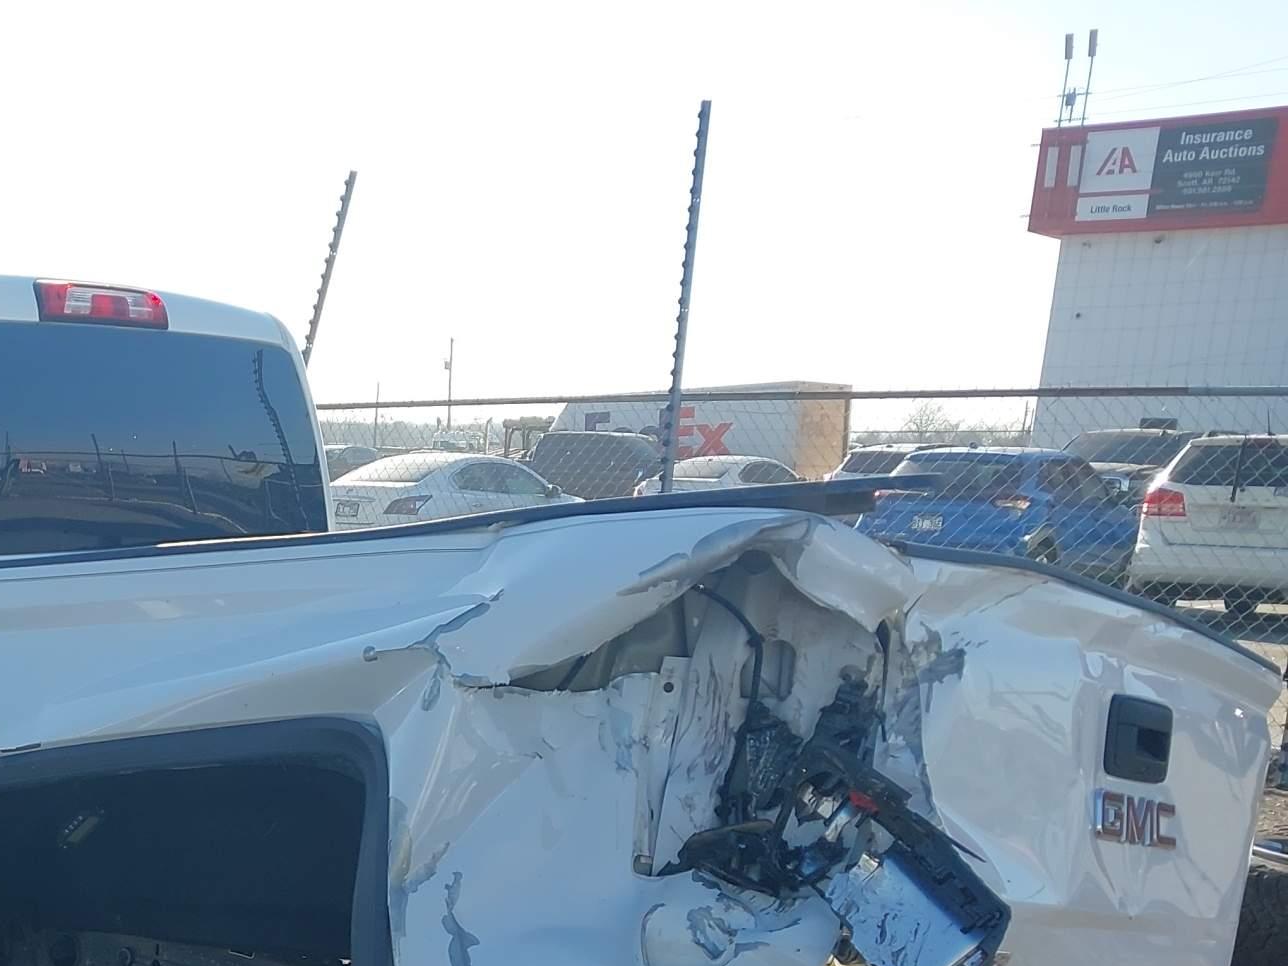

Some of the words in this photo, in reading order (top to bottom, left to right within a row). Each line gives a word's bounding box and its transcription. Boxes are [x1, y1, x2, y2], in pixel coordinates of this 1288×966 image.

[1180, 128, 1253, 145] Insurance
[1163, 149, 1196, 163] Auto
[1199, 144, 1265, 160] Auctions
[1090, 204, 1111, 214] Little
[1112, 204, 1132, 213] Rock
[1093, 788, 1177, 850] GMC
